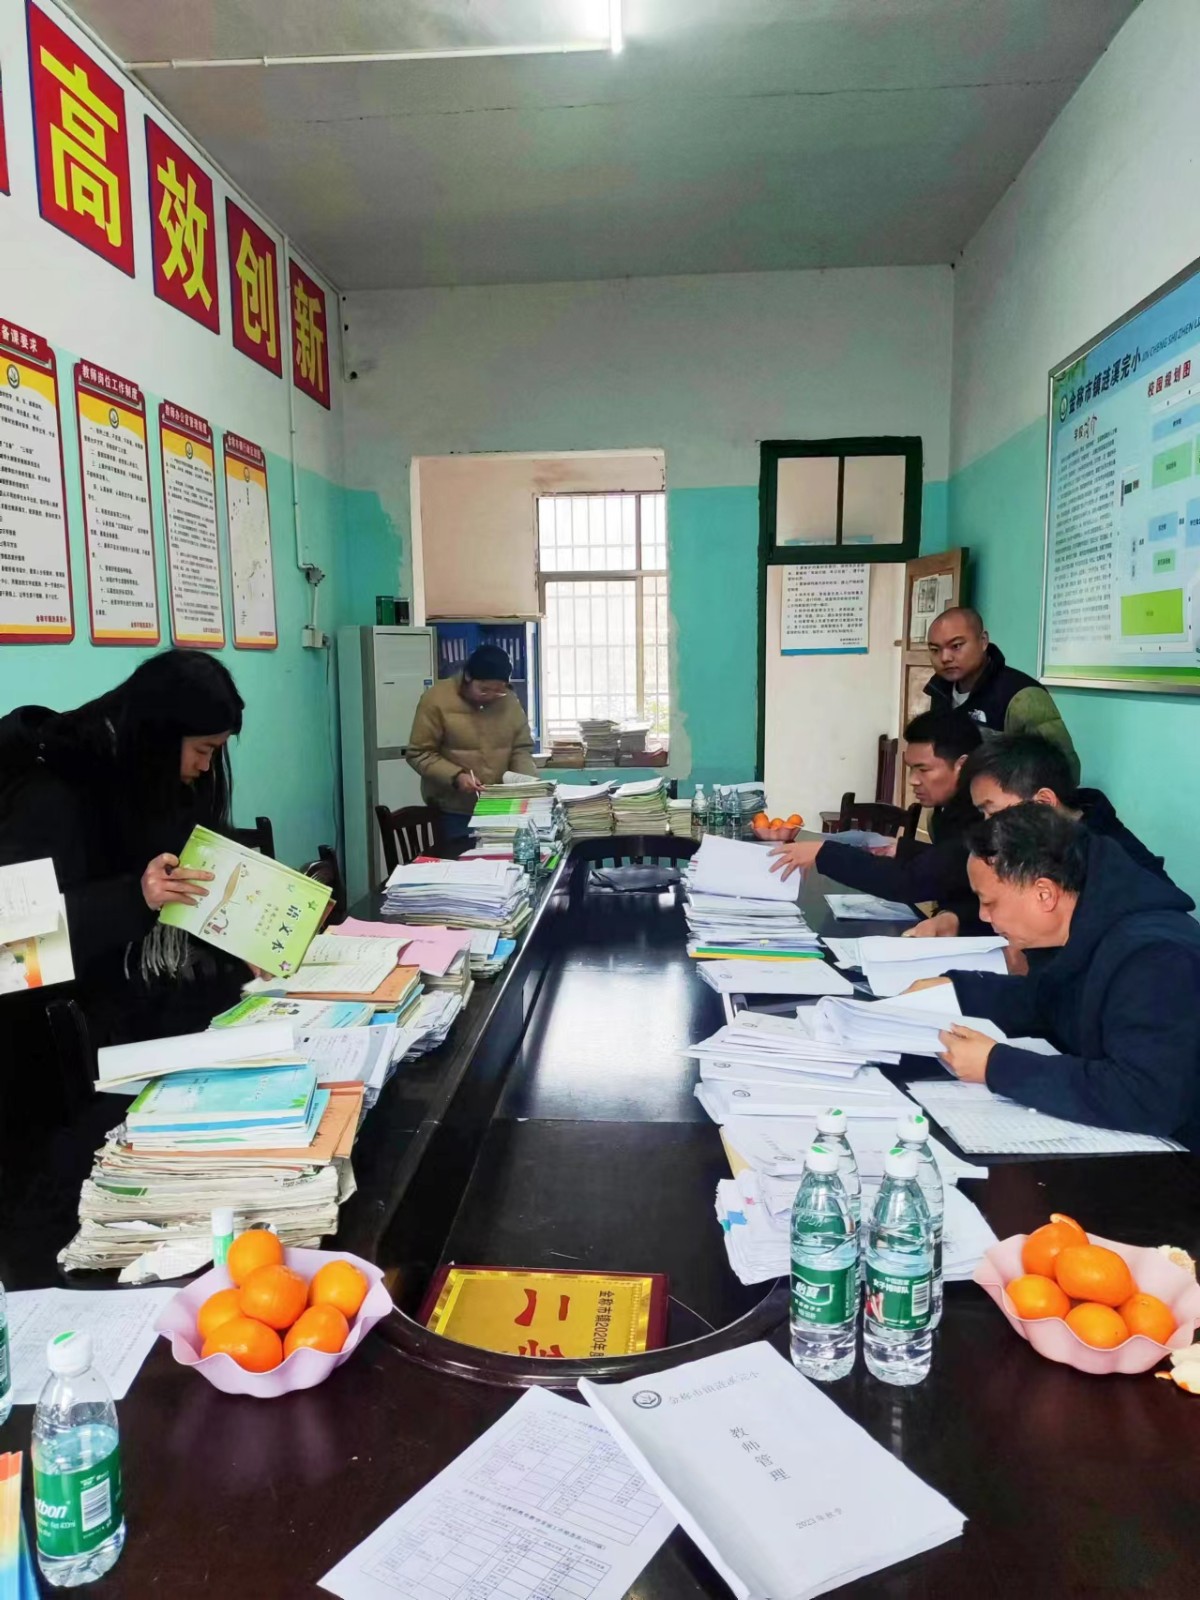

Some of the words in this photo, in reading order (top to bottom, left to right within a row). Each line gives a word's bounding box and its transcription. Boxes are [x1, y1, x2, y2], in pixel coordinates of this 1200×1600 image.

[1, 324, 38, 353] 备课要求
[82, 364, 138, 401] 教师岗位工作制度
[1147, 360, 1191, 398] 校园规划图
[271, 904, 302, 953] 语文本
[729, 1426, 791, 1482] 教师管理
